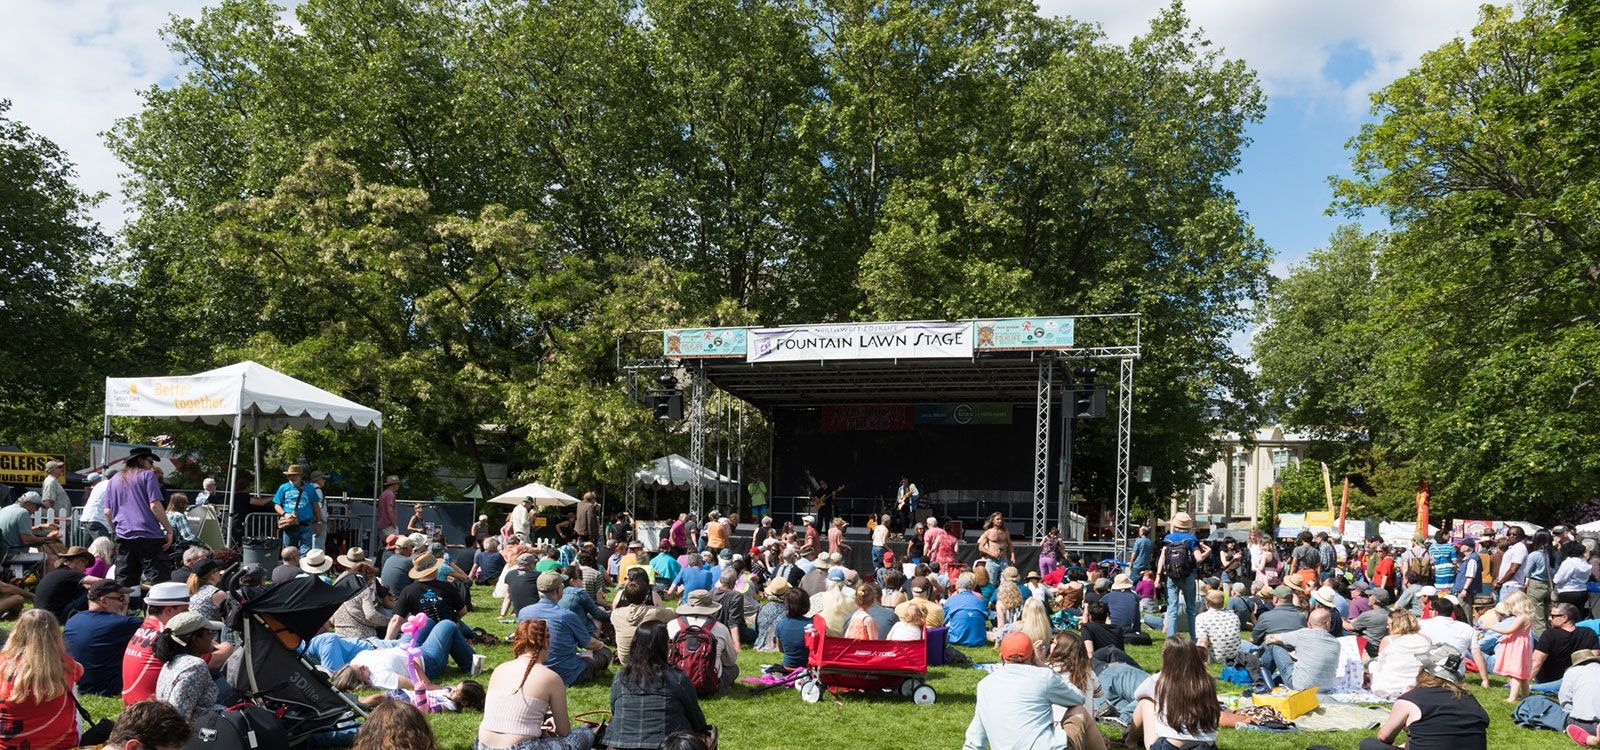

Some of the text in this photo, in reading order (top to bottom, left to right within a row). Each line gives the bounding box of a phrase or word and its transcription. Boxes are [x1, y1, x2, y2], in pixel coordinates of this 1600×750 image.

[776, 337, 853, 351] FOUNTAIN
[859, 334, 907, 348] LAWN
[913, 332, 963, 346] STAGE
[155, 381, 192, 396] Better
[0, 454, 46, 471] GLERS
[0, 473, 30, 483] URST
